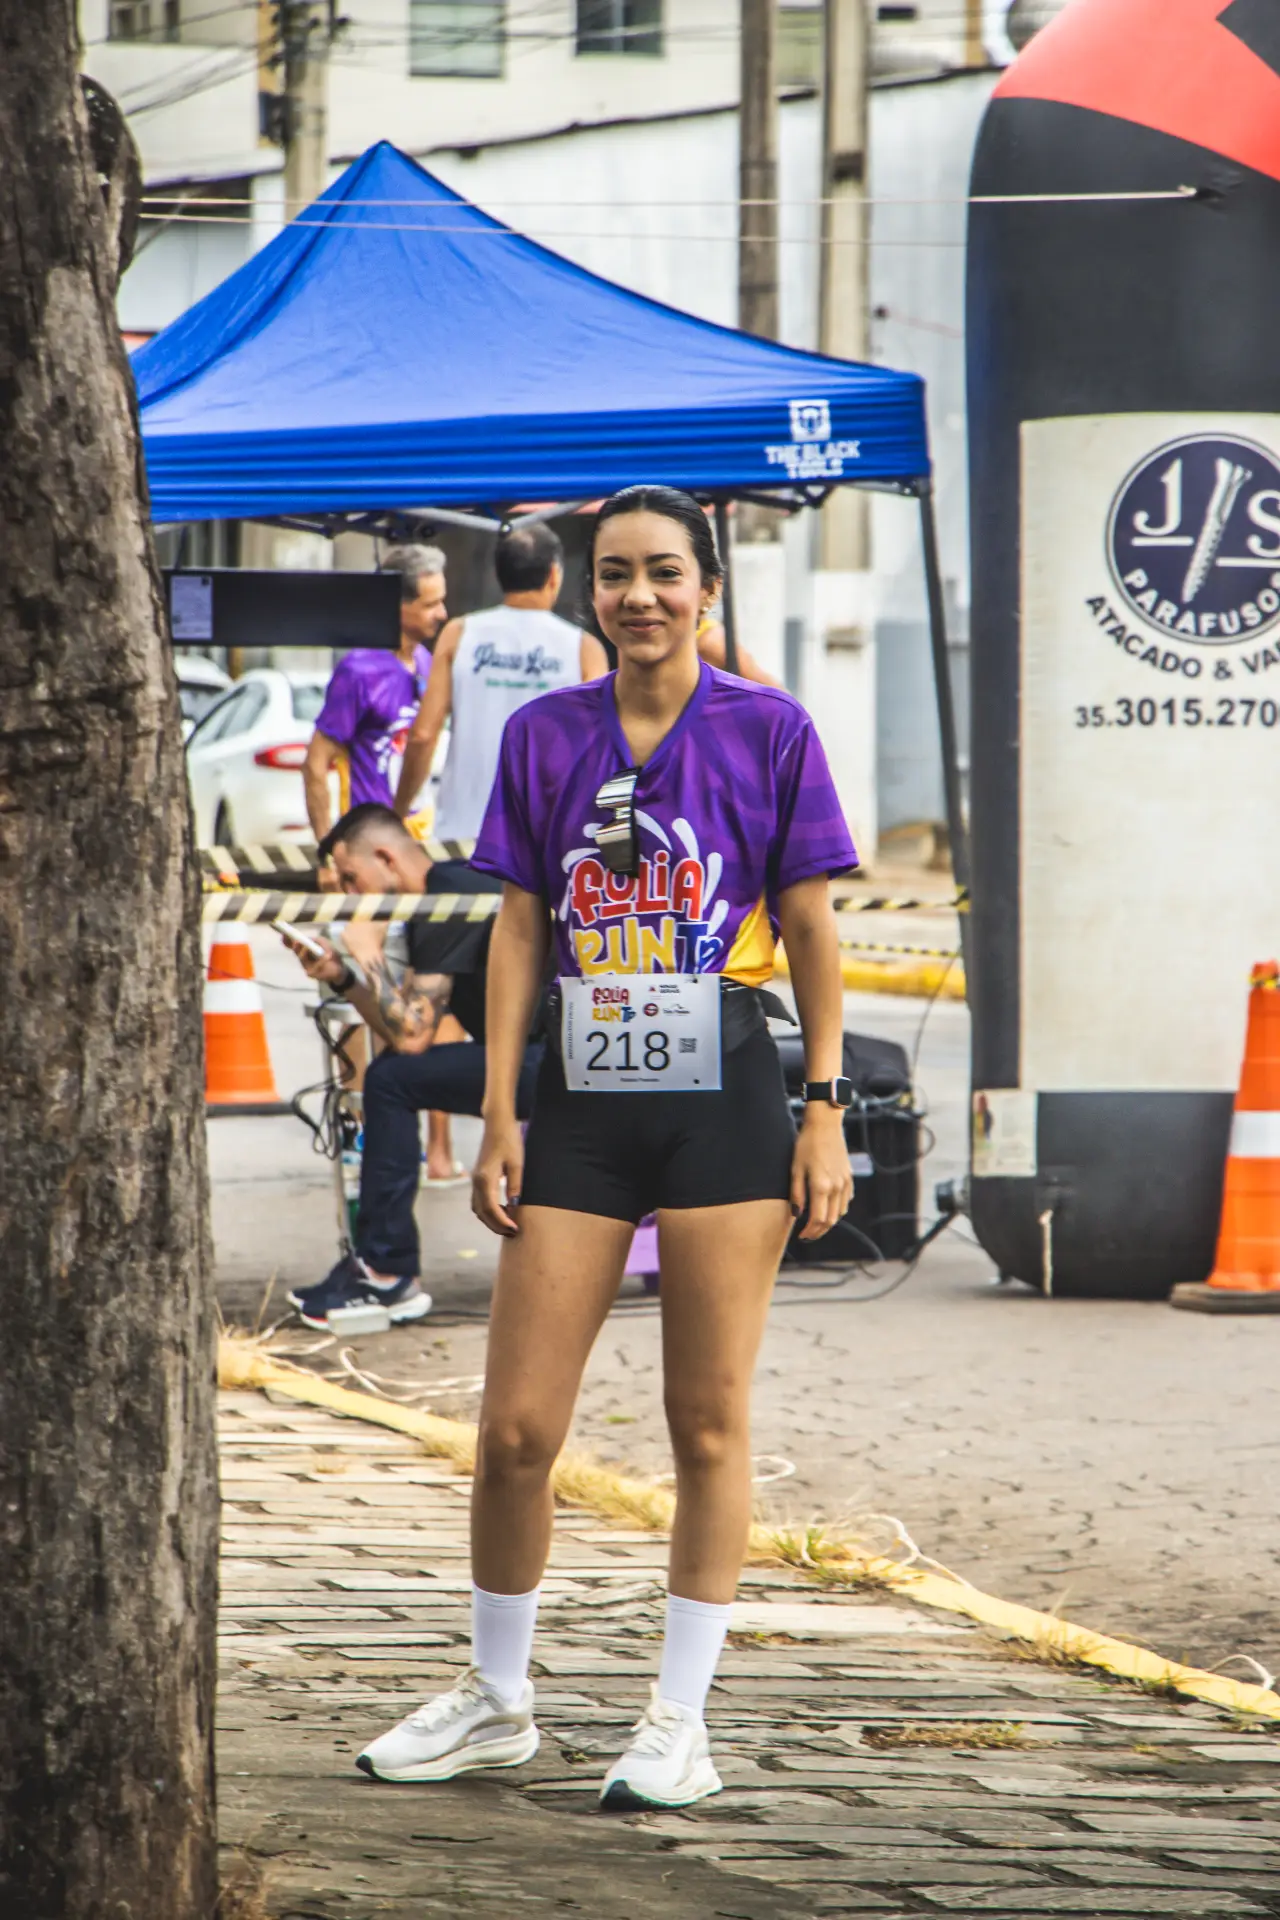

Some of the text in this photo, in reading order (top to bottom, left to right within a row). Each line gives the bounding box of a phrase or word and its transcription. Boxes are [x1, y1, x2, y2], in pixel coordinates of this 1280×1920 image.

[1085, 595, 1203, 680] ATACADO
[1213, 658, 1233, 681] &
[1074, 697, 1280, 729] 35.3015.270
[586, 1031, 671, 1071] 218
